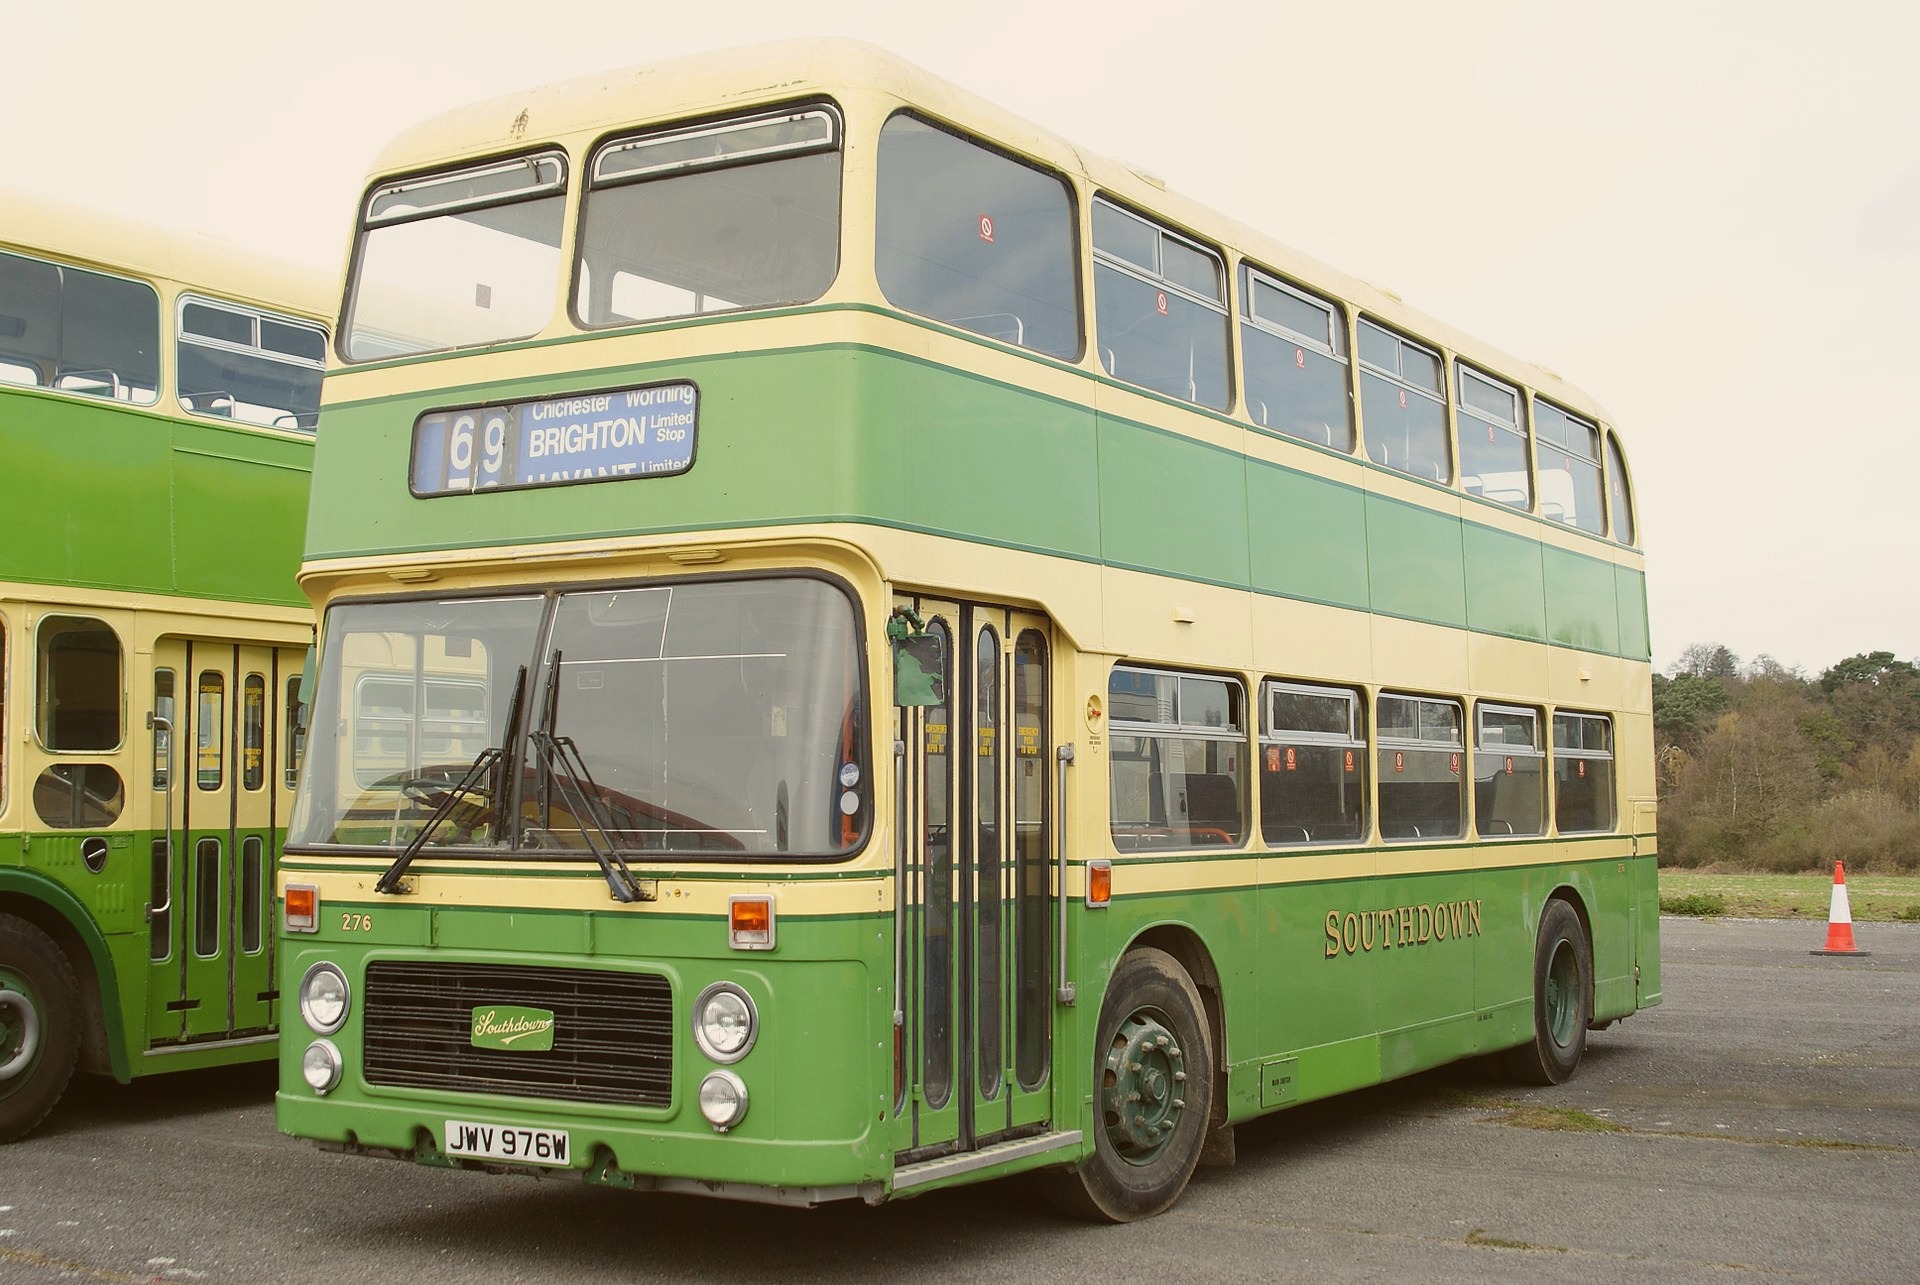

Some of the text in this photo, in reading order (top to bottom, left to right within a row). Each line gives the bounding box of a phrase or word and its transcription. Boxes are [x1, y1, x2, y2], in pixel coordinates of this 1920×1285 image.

[532, 396, 611, 421] Chichester
[650, 410, 693, 429] Limited
[529, 416, 646, 458] BRIGHTON
[656, 428, 686, 442] Stop
[342, 912, 372, 932] 276
[1325, 899, 1482, 960] SOUTHDOWN
[474, 1010, 547, 1036] Southdown
[450, 1125, 567, 1160] JWV 976W
